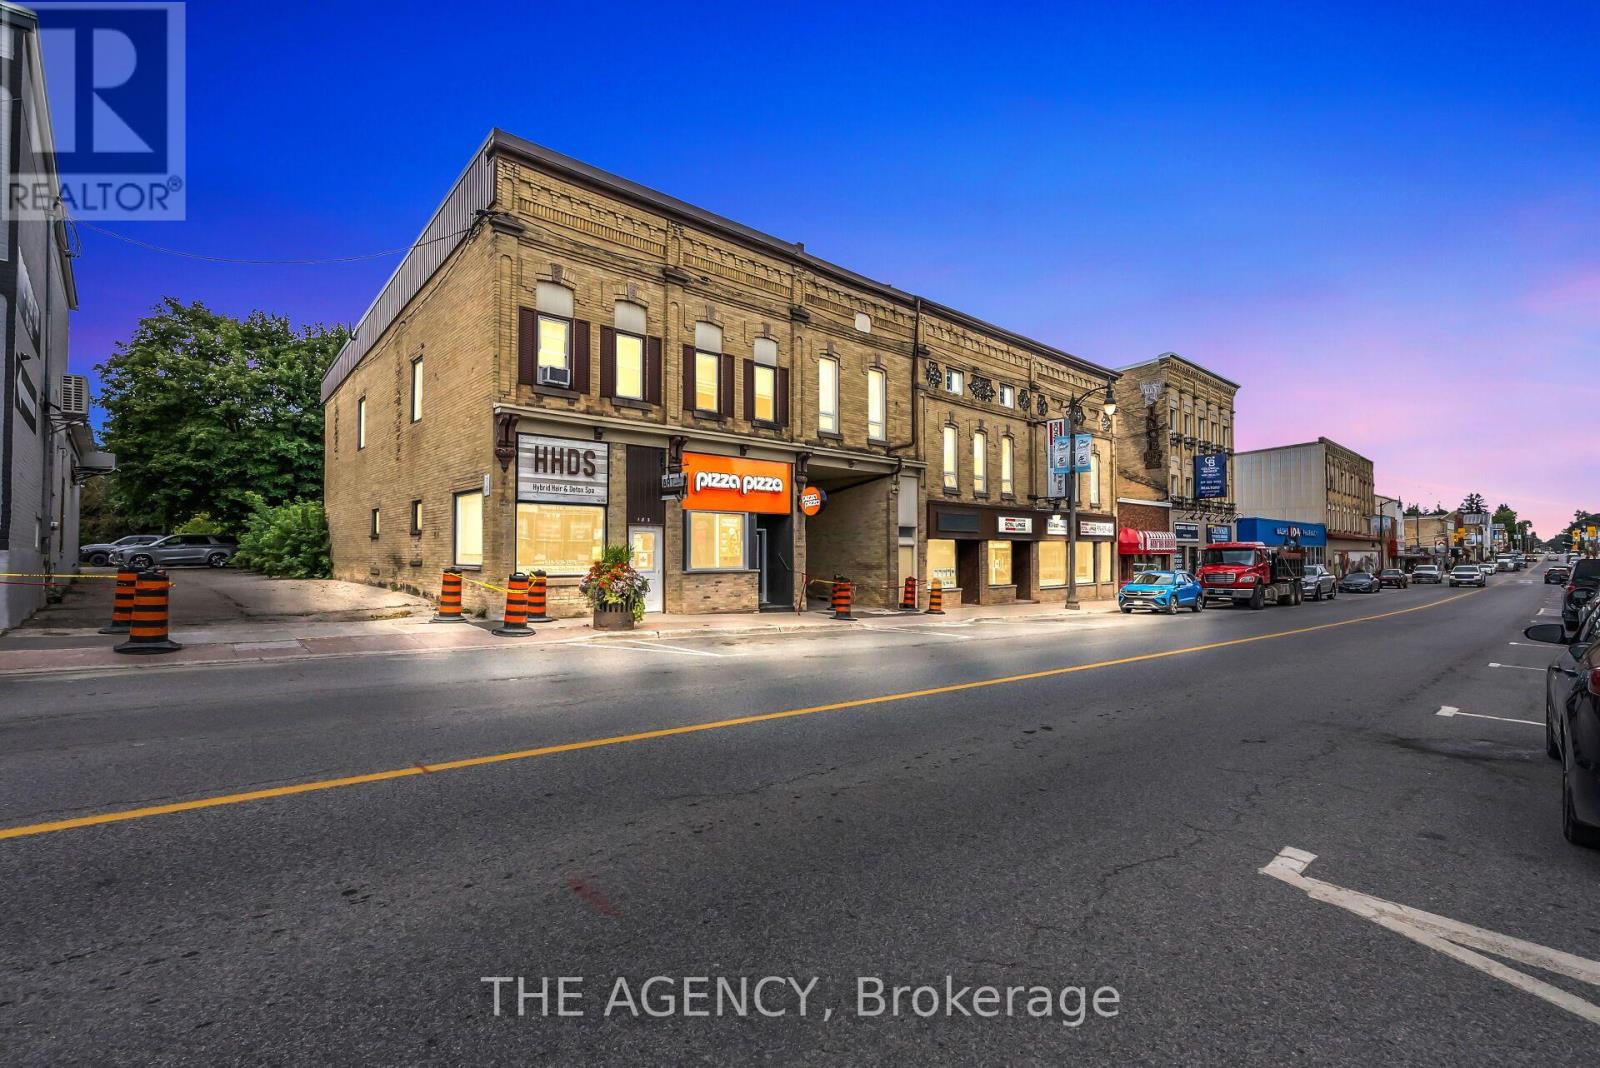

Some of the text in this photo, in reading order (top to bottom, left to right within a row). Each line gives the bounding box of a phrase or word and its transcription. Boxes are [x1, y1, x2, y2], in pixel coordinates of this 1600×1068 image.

[534, 445, 597, 477] HHDS
[532, 483, 551, 494] Hybrid
[551, 484, 563, 492] Hair
[569, 485, 584, 493] Detox
[585, 486, 595, 494] Spa
[695, 471, 740, 492] pizza
[742, 475, 783, 495] pizza
